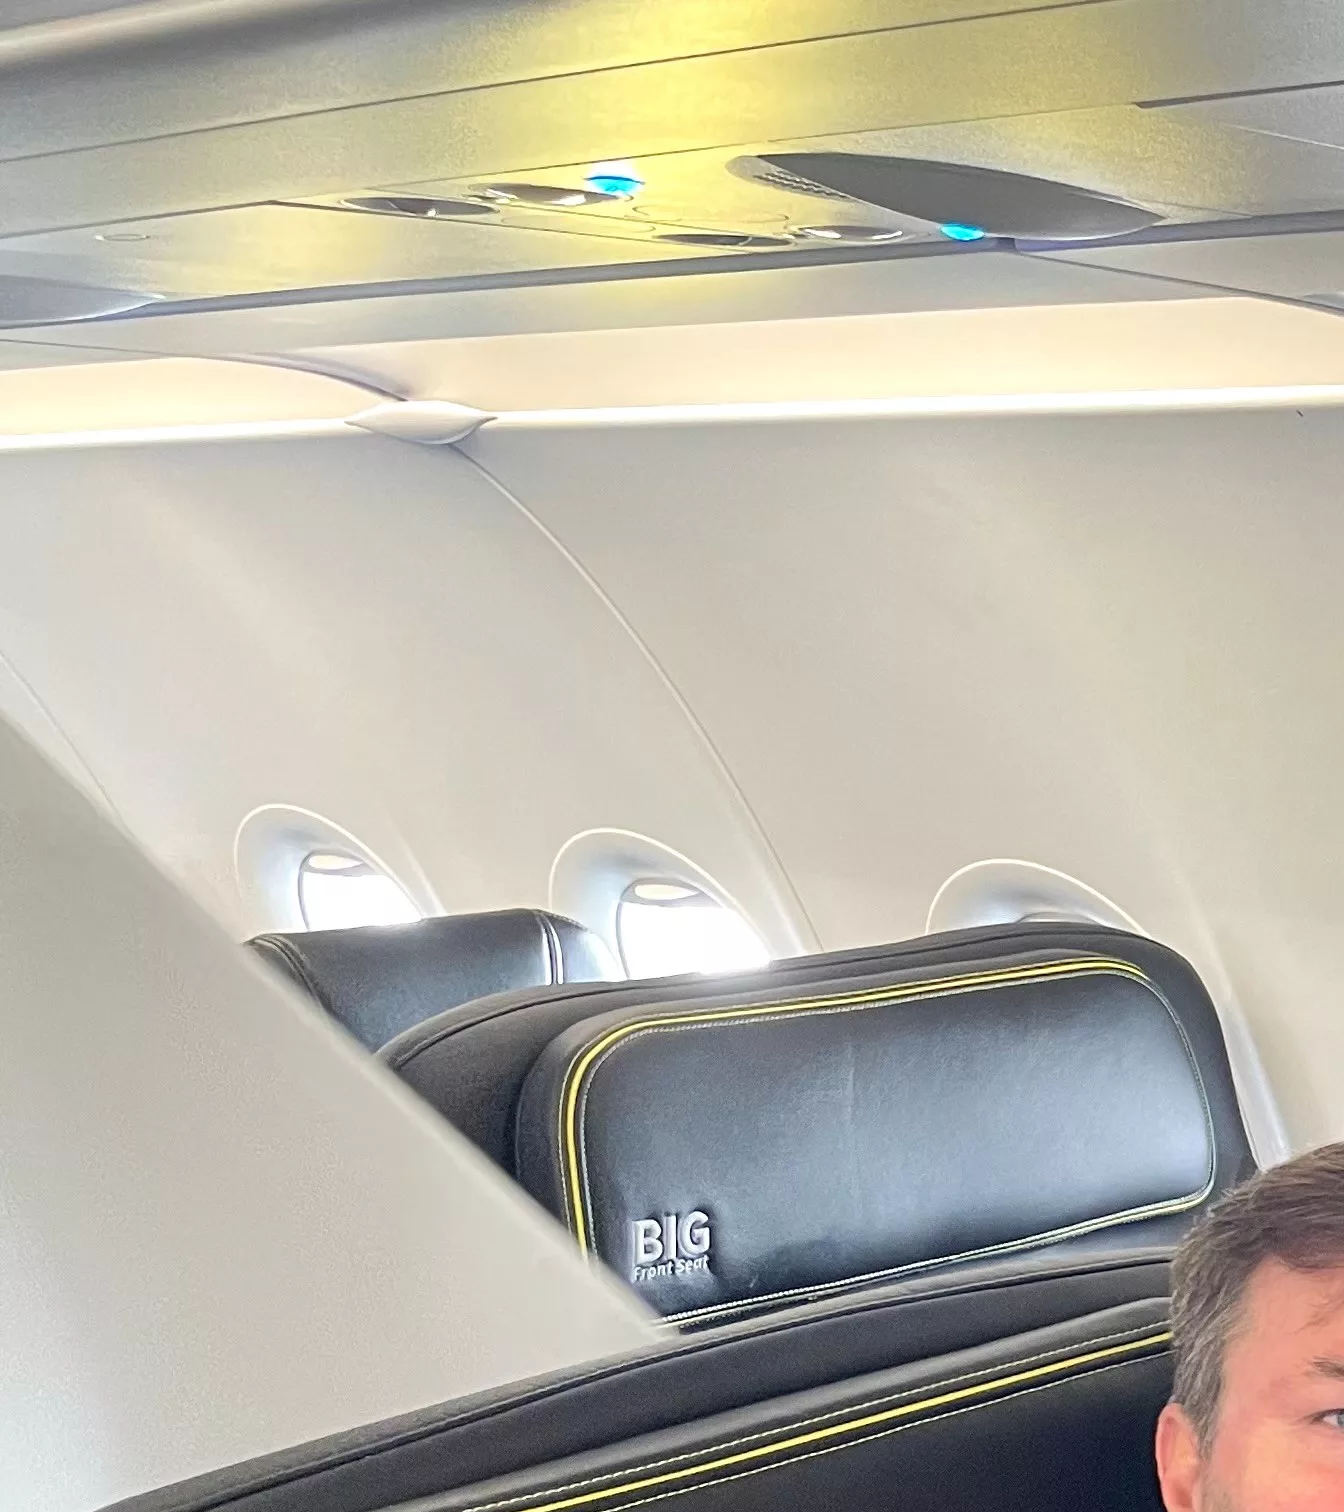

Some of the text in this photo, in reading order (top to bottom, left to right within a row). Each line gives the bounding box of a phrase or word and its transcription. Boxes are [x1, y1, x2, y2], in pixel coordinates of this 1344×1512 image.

[632, 1210, 710, 1265] BIG
[633, 1254, 710, 1282] Front Seat
